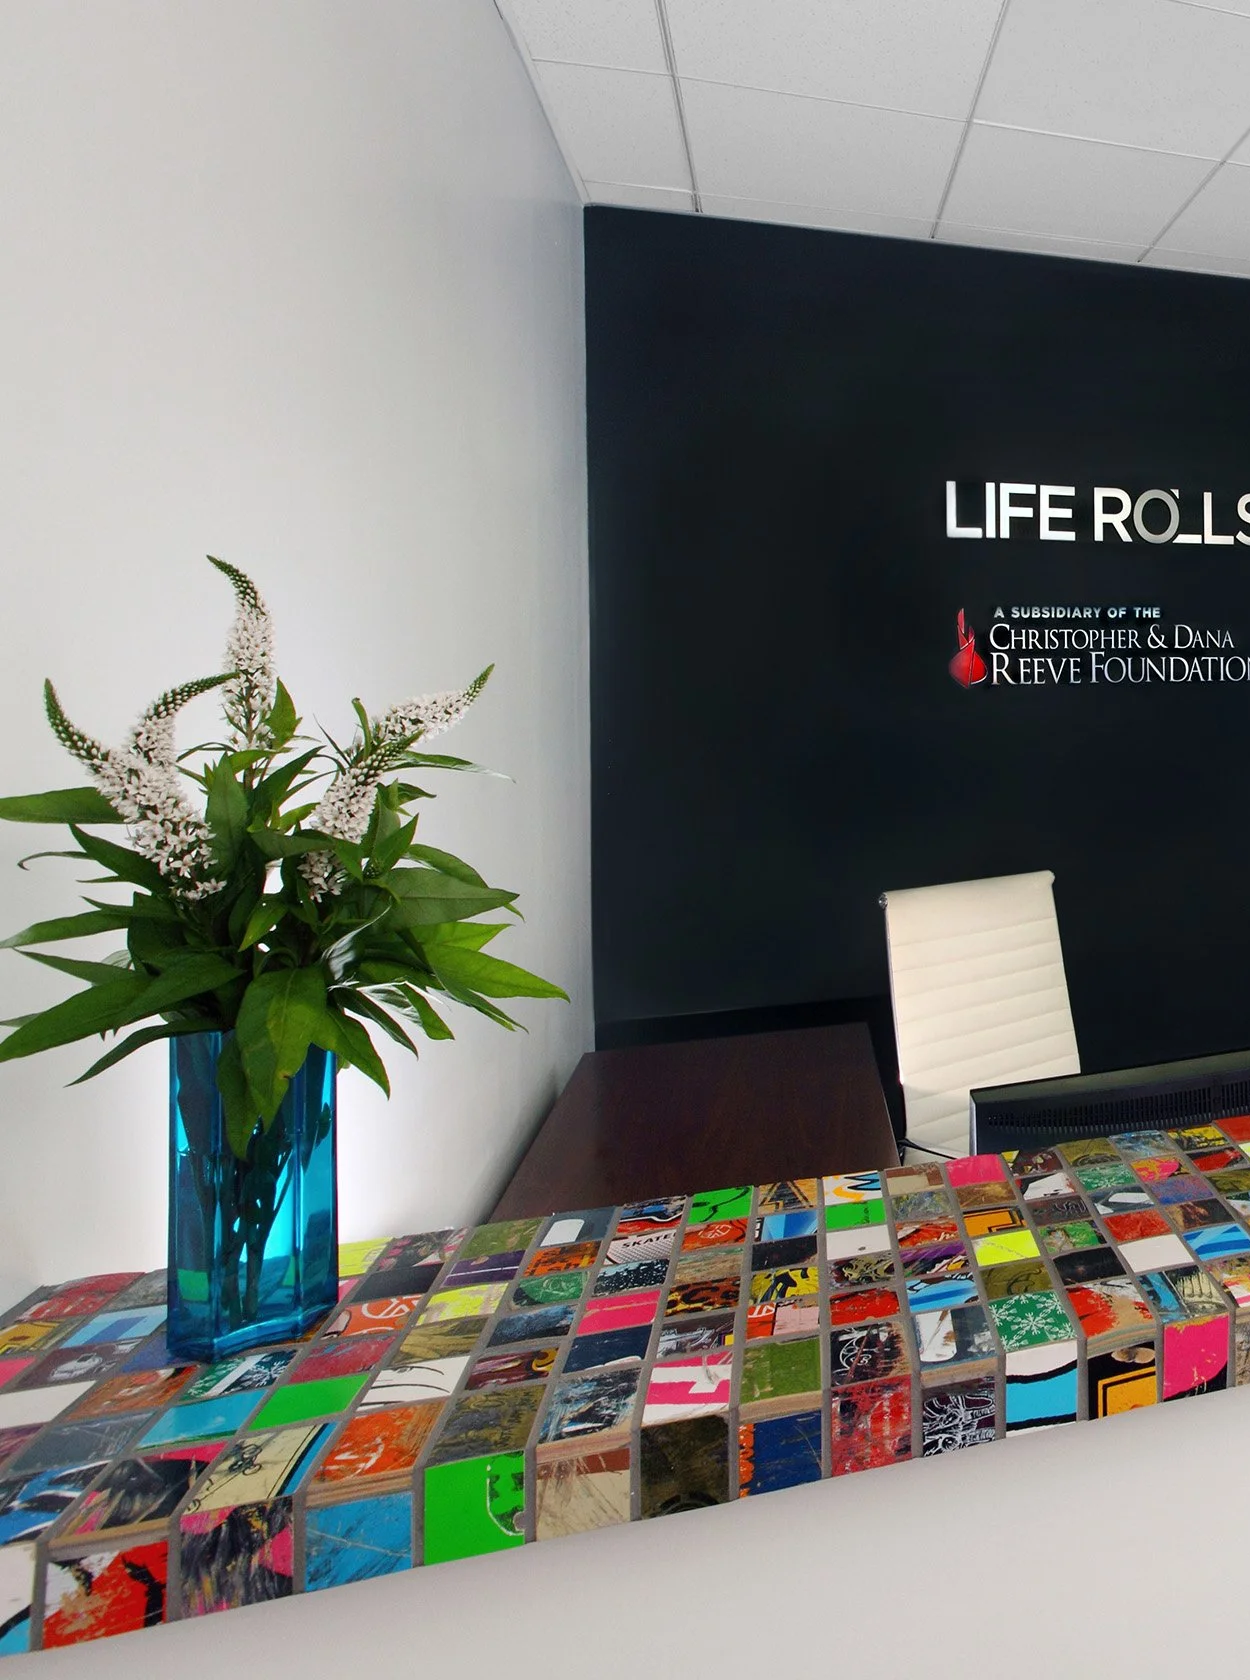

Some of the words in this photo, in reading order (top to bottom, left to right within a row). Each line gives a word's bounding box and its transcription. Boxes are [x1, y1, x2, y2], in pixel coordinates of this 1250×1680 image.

[946, 481, 1076, 541] LIFE
[993, 606, 1005, 619] A
[1010, 606, 1102, 619] SUBSIDIARY
[1106, 606, 1127, 619] OF
[1133, 606, 1161, 619] THE
[1146, 623, 1168, 649] &
[990, 651, 1082, 686] REEVE
